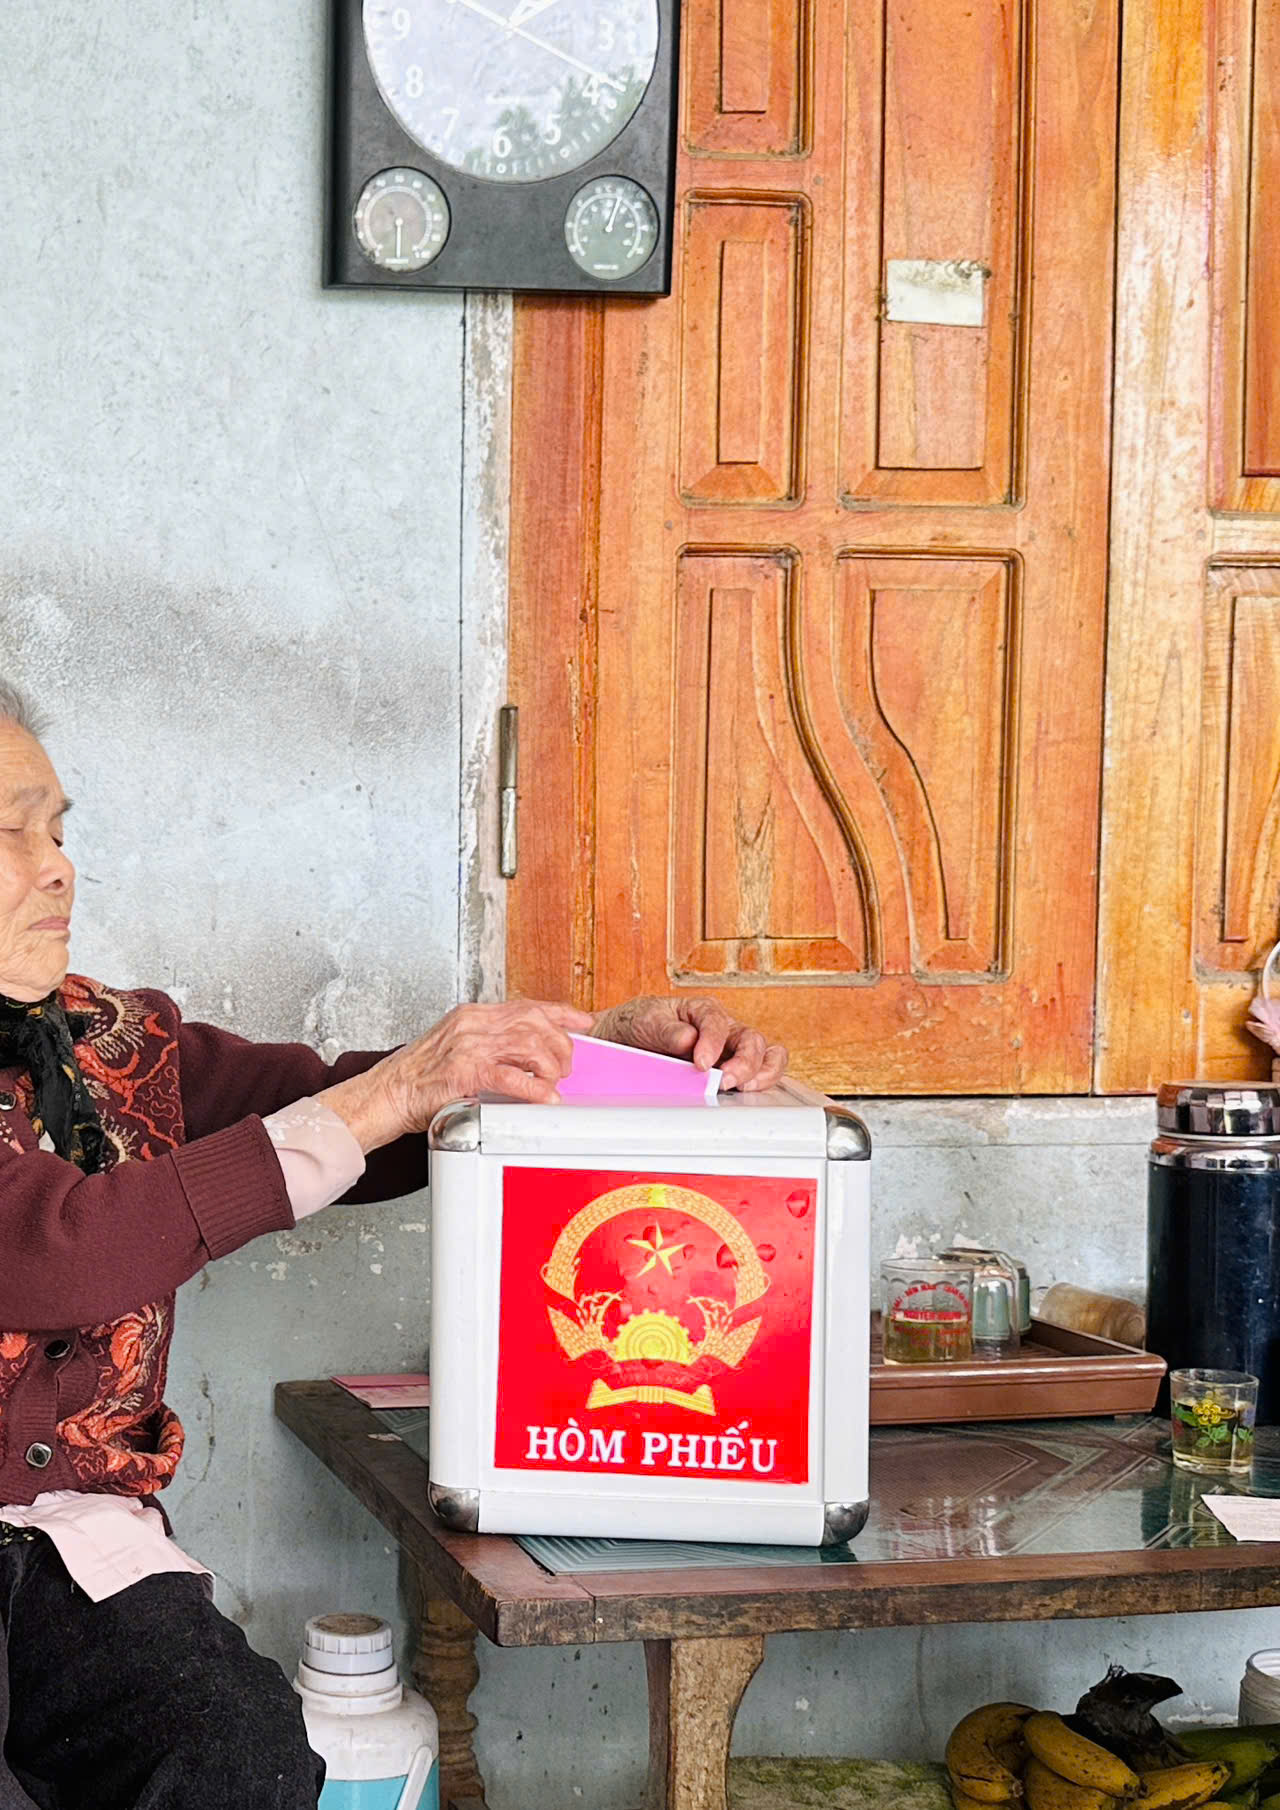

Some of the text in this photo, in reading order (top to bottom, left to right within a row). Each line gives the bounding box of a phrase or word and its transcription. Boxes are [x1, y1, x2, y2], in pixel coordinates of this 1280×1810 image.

[392, 8, 411, 40] 9
[598, 18, 616, 51] 3
[405, 64, 424, 98] 8
[582, 73, 601, 105] 4
[442, 107, 461, 140] 7
[543, 113, 562, 145] 5
[492, 127, 512, 158] 6
[525, 1418, 777, 1472] HÒM PHIẾU
